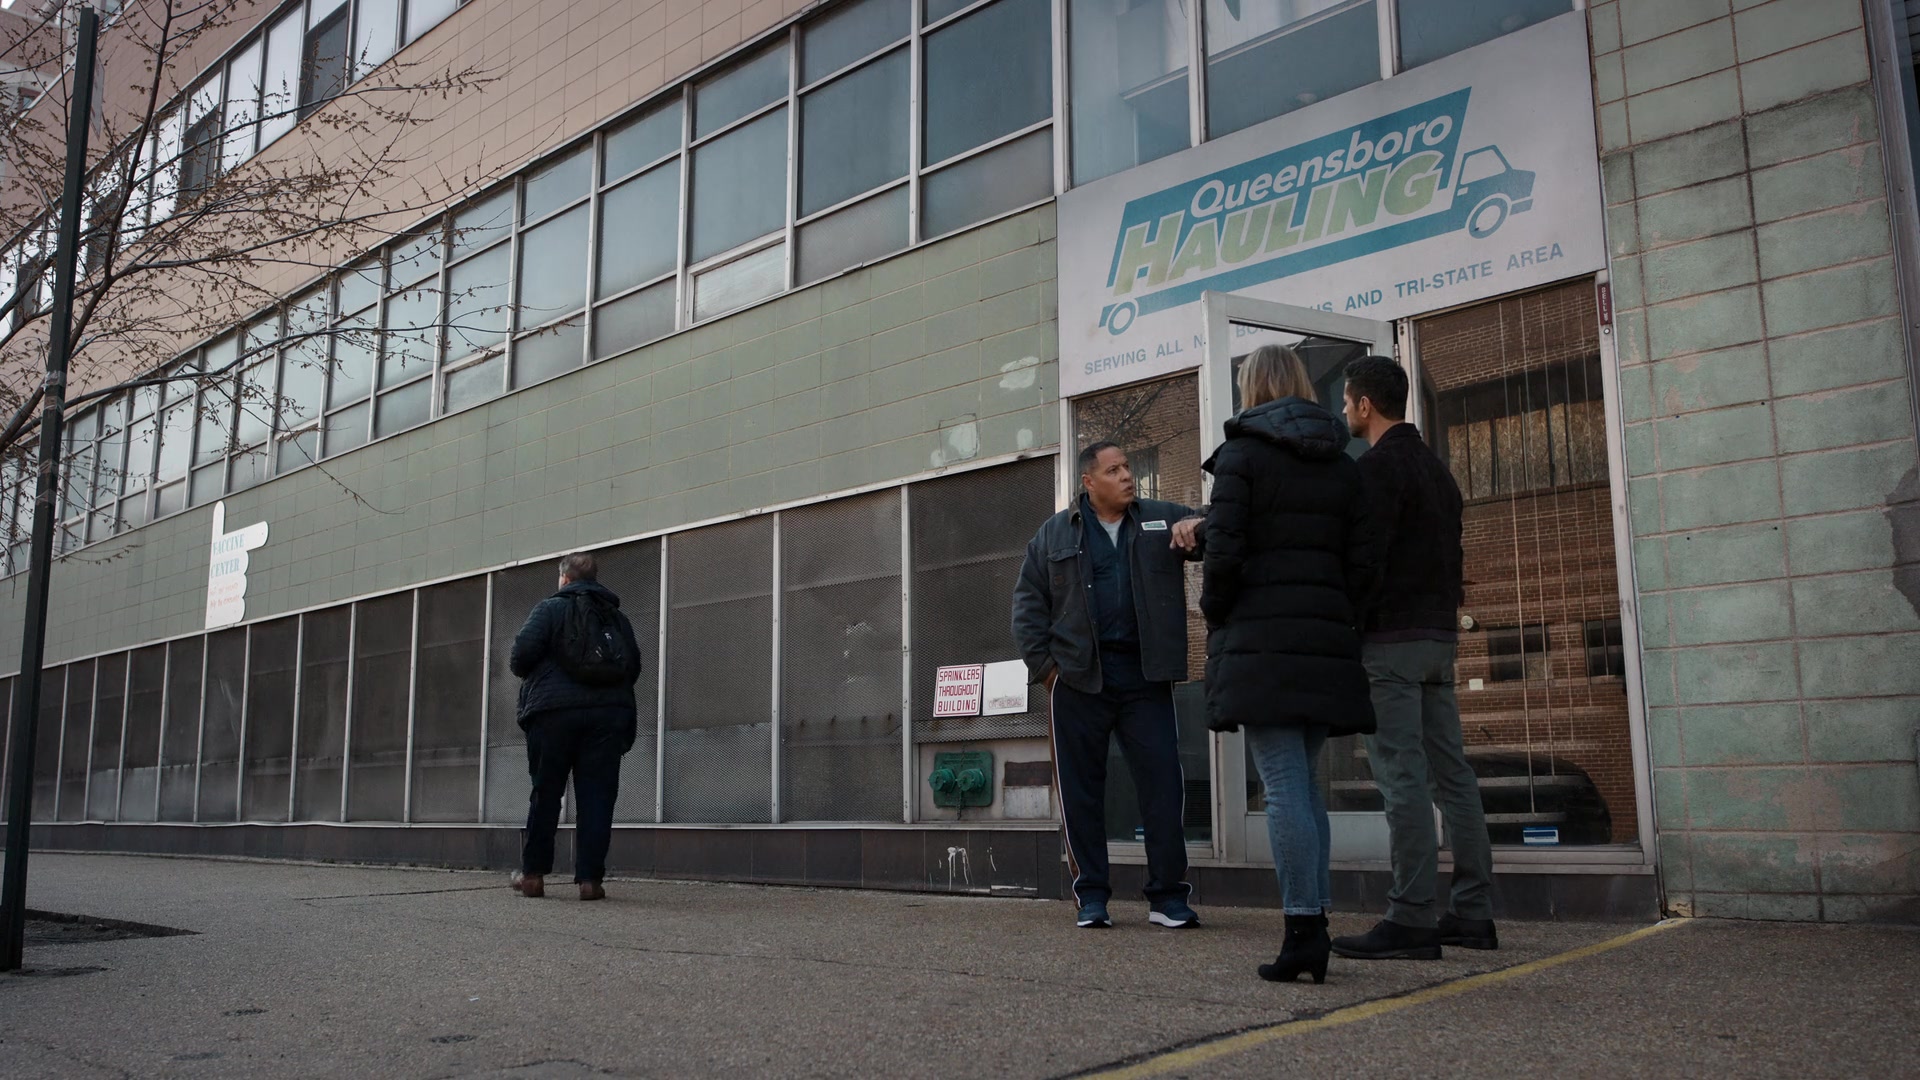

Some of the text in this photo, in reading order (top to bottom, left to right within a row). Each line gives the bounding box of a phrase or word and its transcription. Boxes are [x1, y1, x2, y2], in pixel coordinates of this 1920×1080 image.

[1190, 115, 1453, 218] Queensboro
[1112, 151, 1444, 297] HAULING
[1084, 348, 1147, 375] SERVING
[1156, 340, 1183, 358] ALL
[1344, 289, 1383, 312] AND
[1394, 260, 1493, 298] TRI-STATE
[1506, 242, 1564, 271] AREA
[212, 533, 245, 555] VACCINE
[210, 557, 240, 578] CENTER
[939, 668, 980, 682] SPRINKLERS
[938, 684, 978, 697] THROUGHOUT
[937, 699, 976, 712] BUILDING
